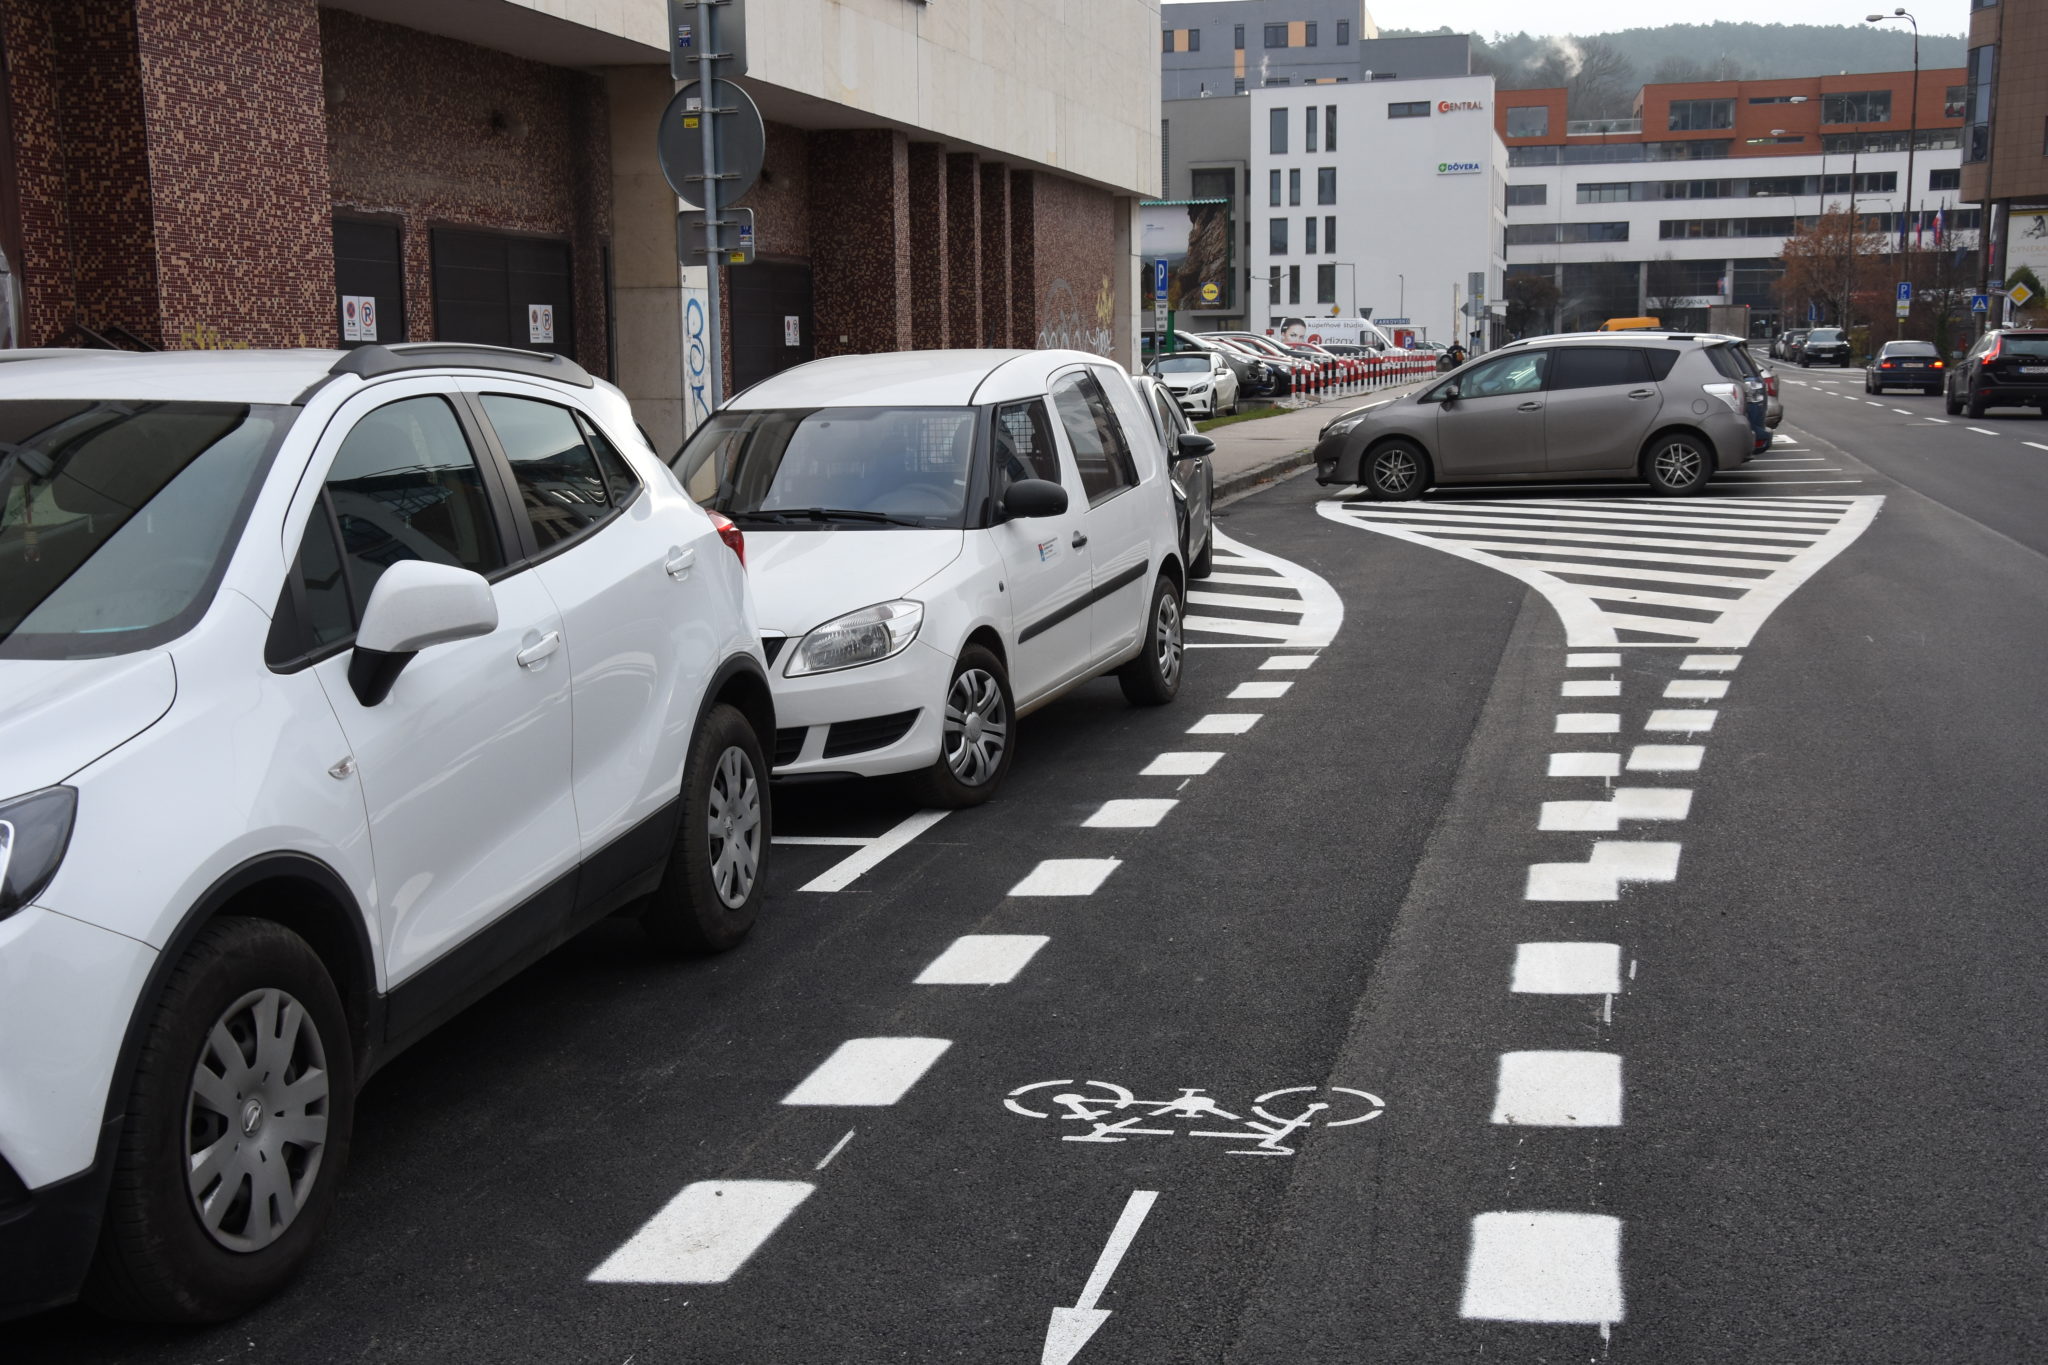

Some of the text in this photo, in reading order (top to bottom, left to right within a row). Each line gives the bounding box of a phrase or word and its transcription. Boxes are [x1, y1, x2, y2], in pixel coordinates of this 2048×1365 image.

[1440, 101, 1483, 112] CENTRAL
[1447, 162, 1479, 171] DÔVERA
[1158, 263, 1165, 288] P
